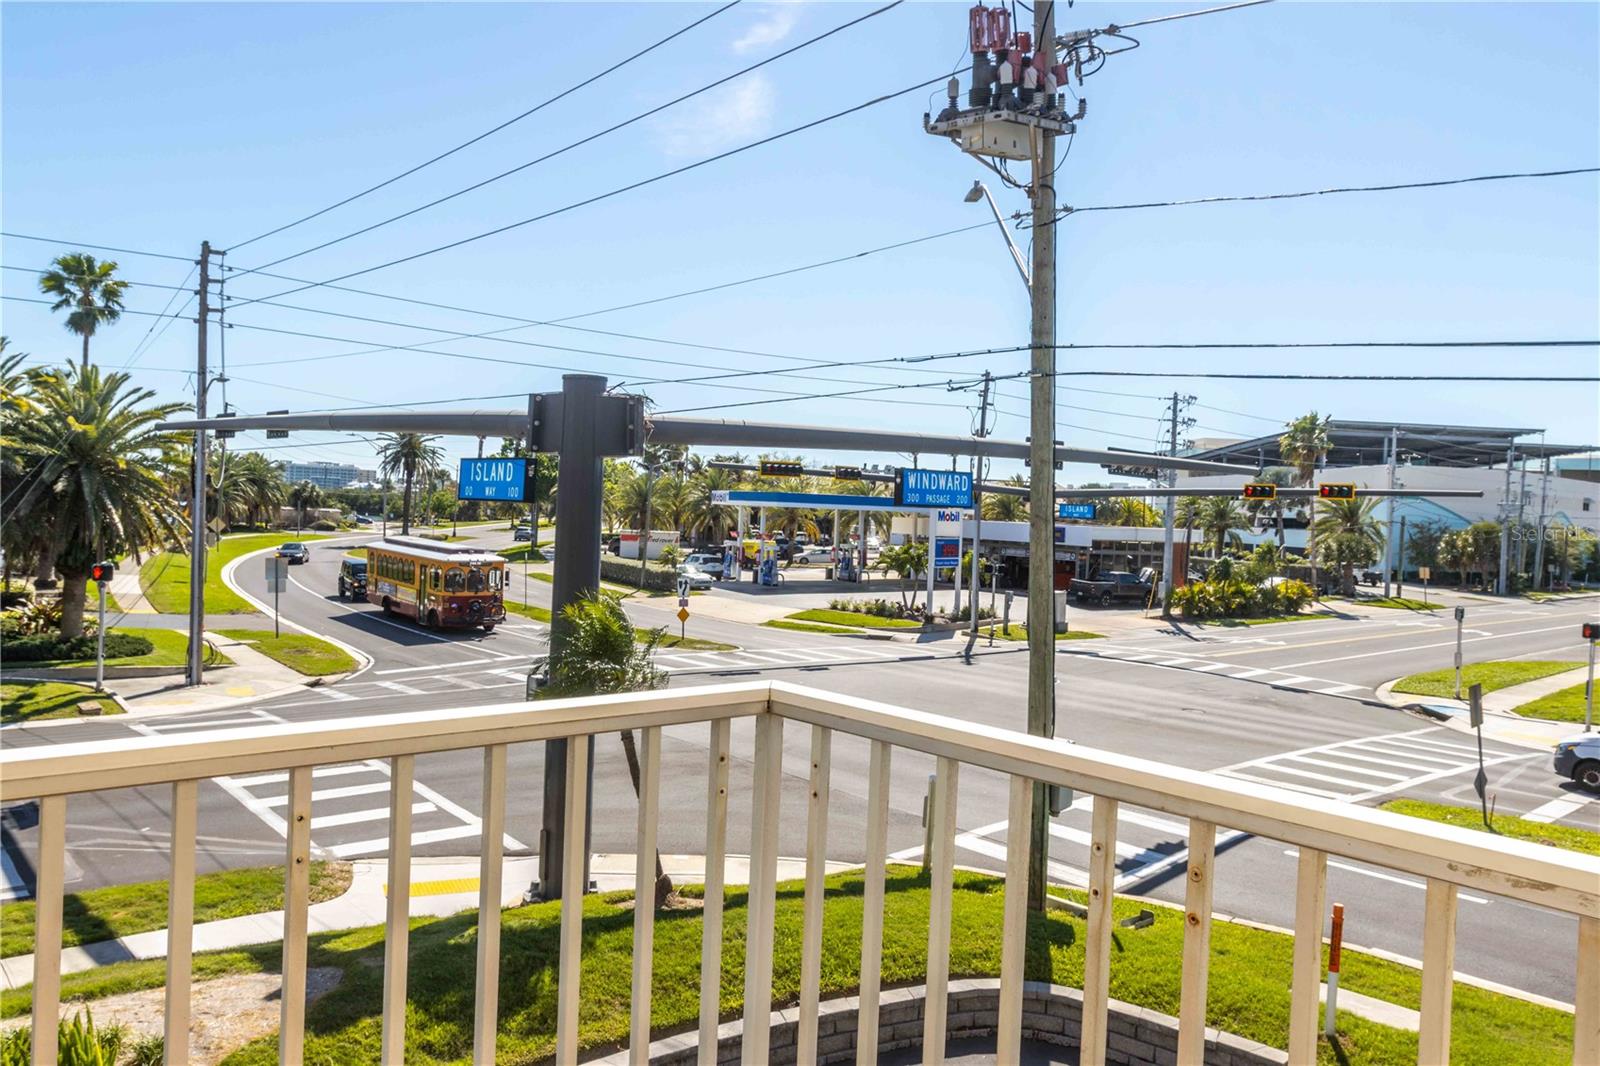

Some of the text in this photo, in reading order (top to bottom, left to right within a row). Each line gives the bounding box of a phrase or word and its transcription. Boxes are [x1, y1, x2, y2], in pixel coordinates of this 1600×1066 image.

[470, 462, 514, 482] ISLAND
[907, 471, 969, 492] WINDWARD
[464, 486, 519, 498] 00 WAY 100
[907, 493, 968, 504] 300 PASSAGE 200
[1064, 505, 1089, 513] ISLAND
[937, 510, 960, 522] Mobil
